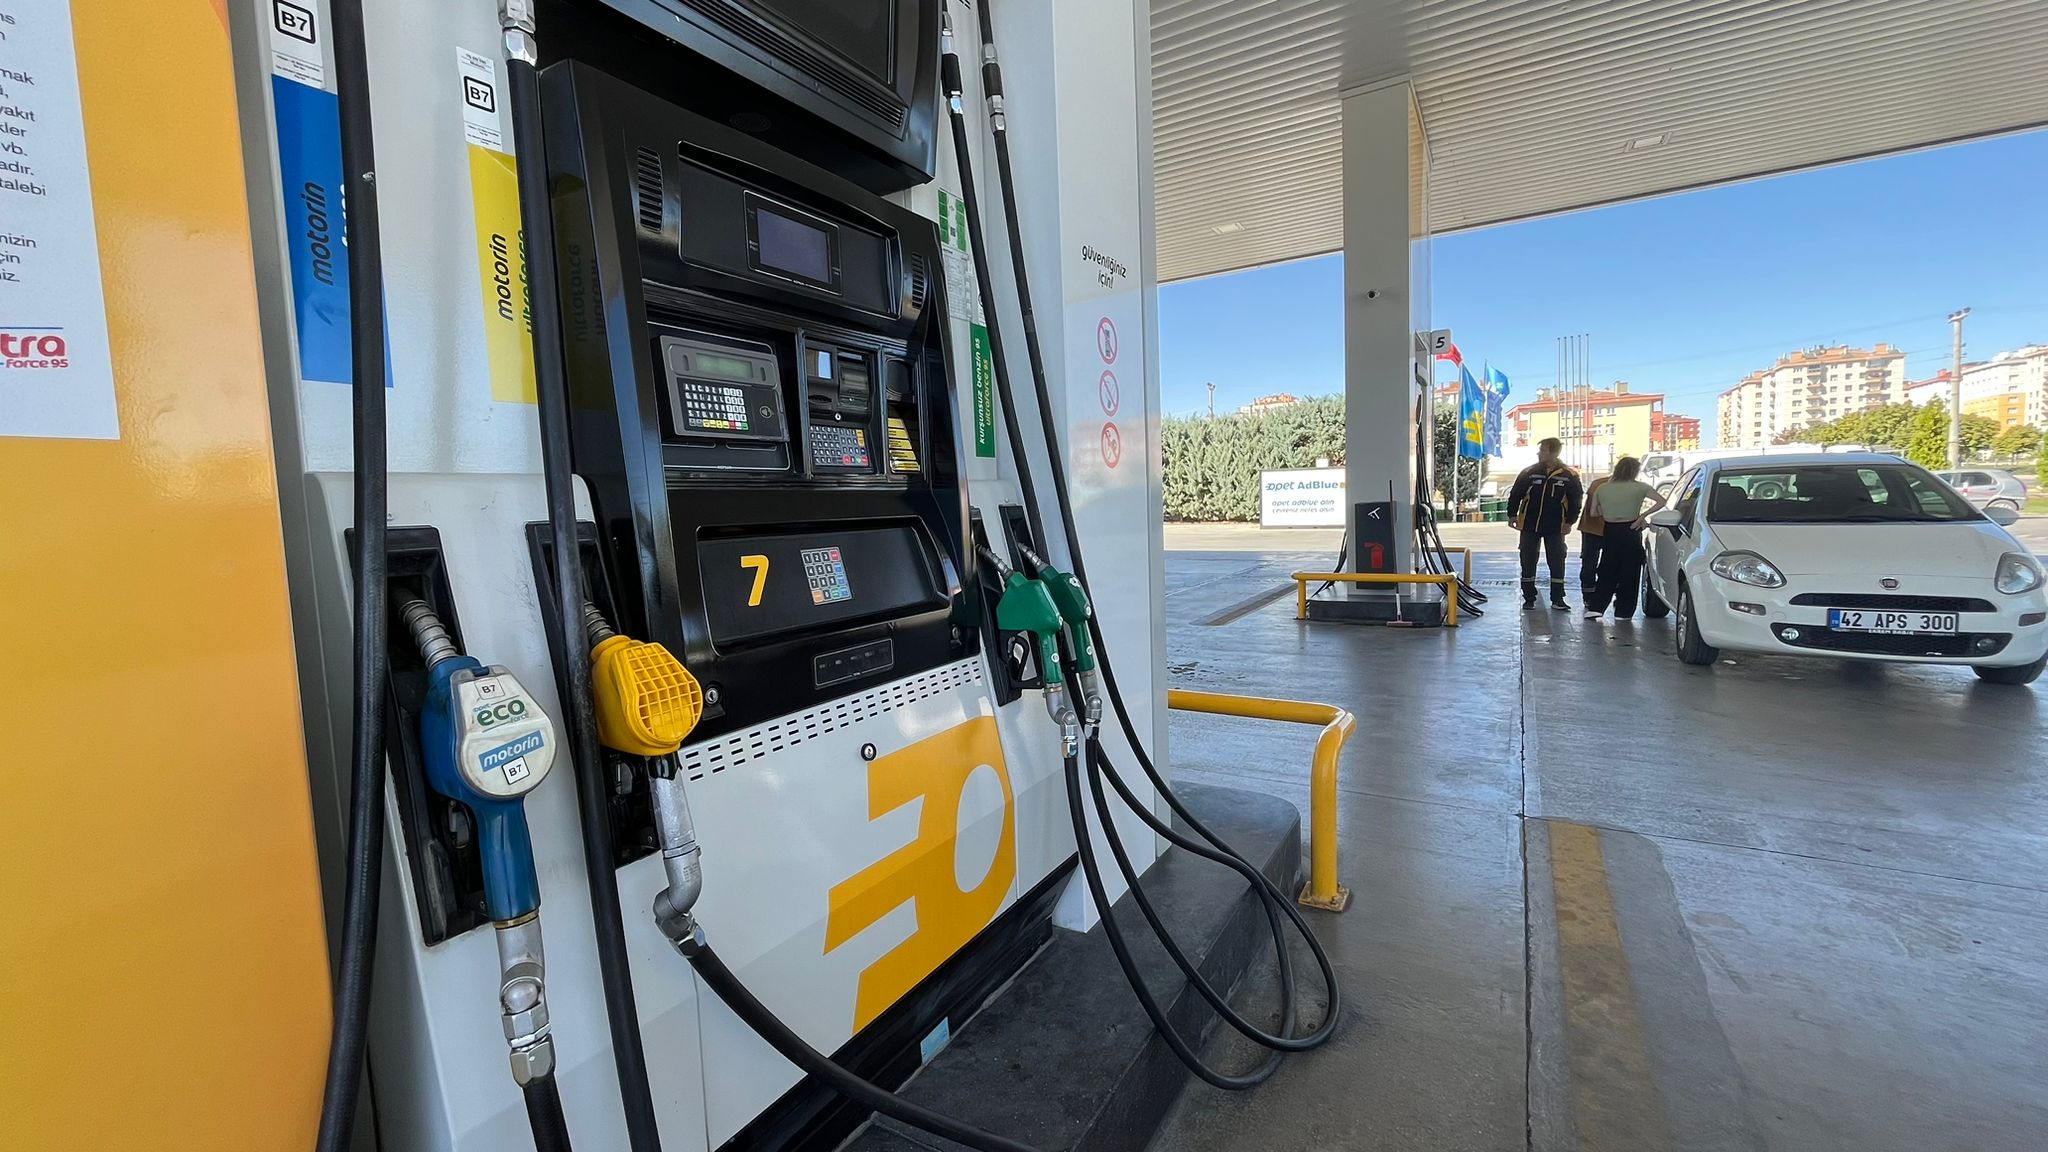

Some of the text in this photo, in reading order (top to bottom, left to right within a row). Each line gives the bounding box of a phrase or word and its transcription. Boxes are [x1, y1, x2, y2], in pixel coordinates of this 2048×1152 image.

[282, 10, 308, 31] B7
[470, 86, 489, 103] B7
[1, 141, 28, 157] vb.
[301, 182, 334, 287] motorin
[1081, 245, 1127, 278] güvenliğiniz
[0, 268, 20, 283] iz.
[489, 233, 514, 322] motorin
[0, 333, 66, 358] tra
[974, 337, 981, 350] 95
[1435, 336, 1446, 349] 5
[51, 359, 69, 368] 95
[974, 352, 982, 388] benzin
[1265, 481, 1338, 491] opet AdBlue
[740, 554, 769, 607] 7
[1841, 612, 1954, 630] 42 APS 300
[482, 685, 496, 694] B7
[477, 699, 526, 726] eco
[484, 736, 540, 768] motorin
[509, 765, 522, 777] B7
